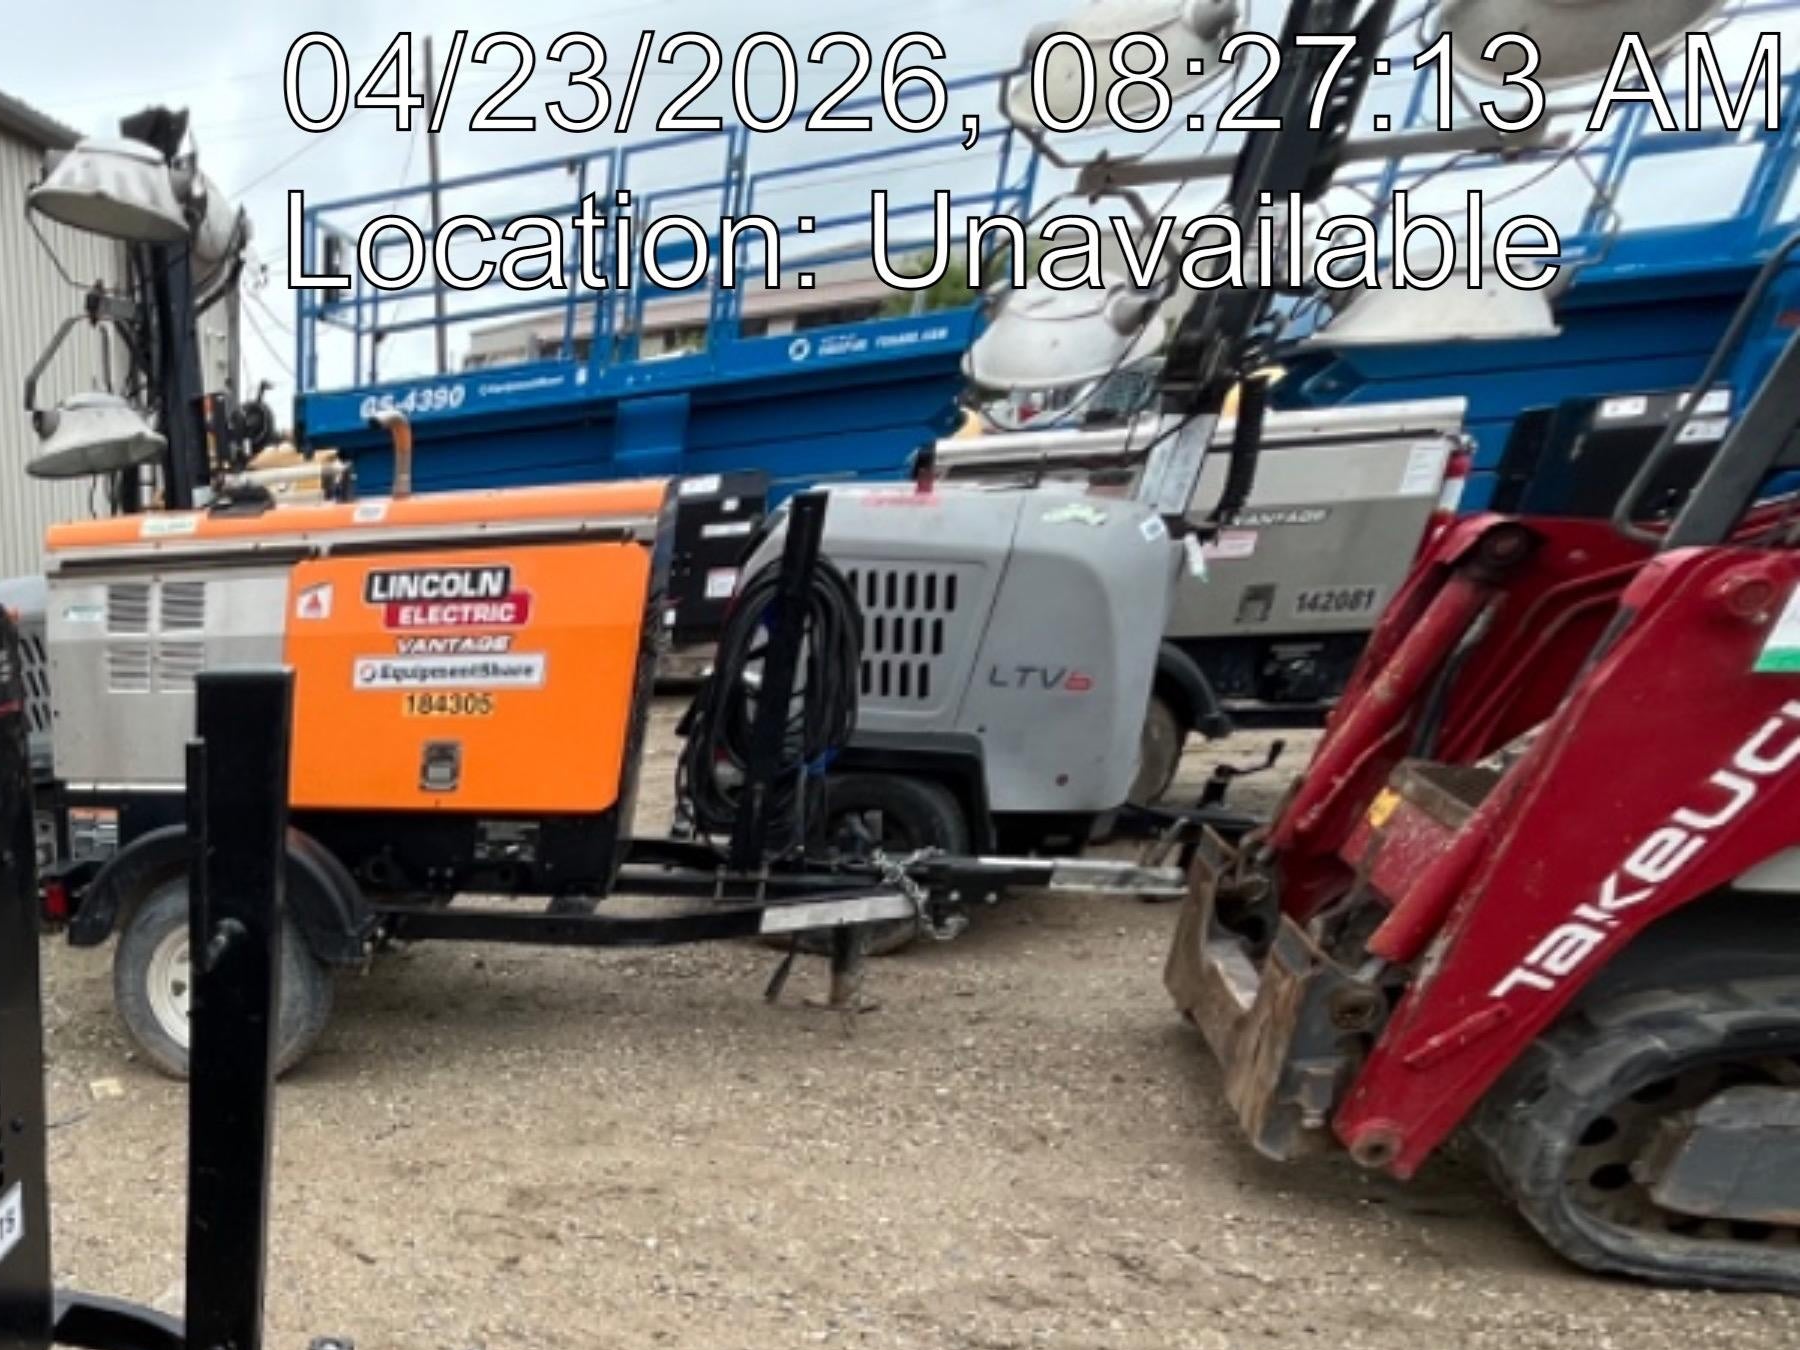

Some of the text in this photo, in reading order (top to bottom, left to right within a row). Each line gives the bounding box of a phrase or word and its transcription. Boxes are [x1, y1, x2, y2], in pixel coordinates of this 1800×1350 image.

[369, 569, 505, 600] LINCOLN
[398, 602, 517, 625] ELECTRIC
[397, 634, 512, 654] VANTAGE
[380, 661, 535, 682] EquipmentShare
[406, 692, 493, 715] 184305
